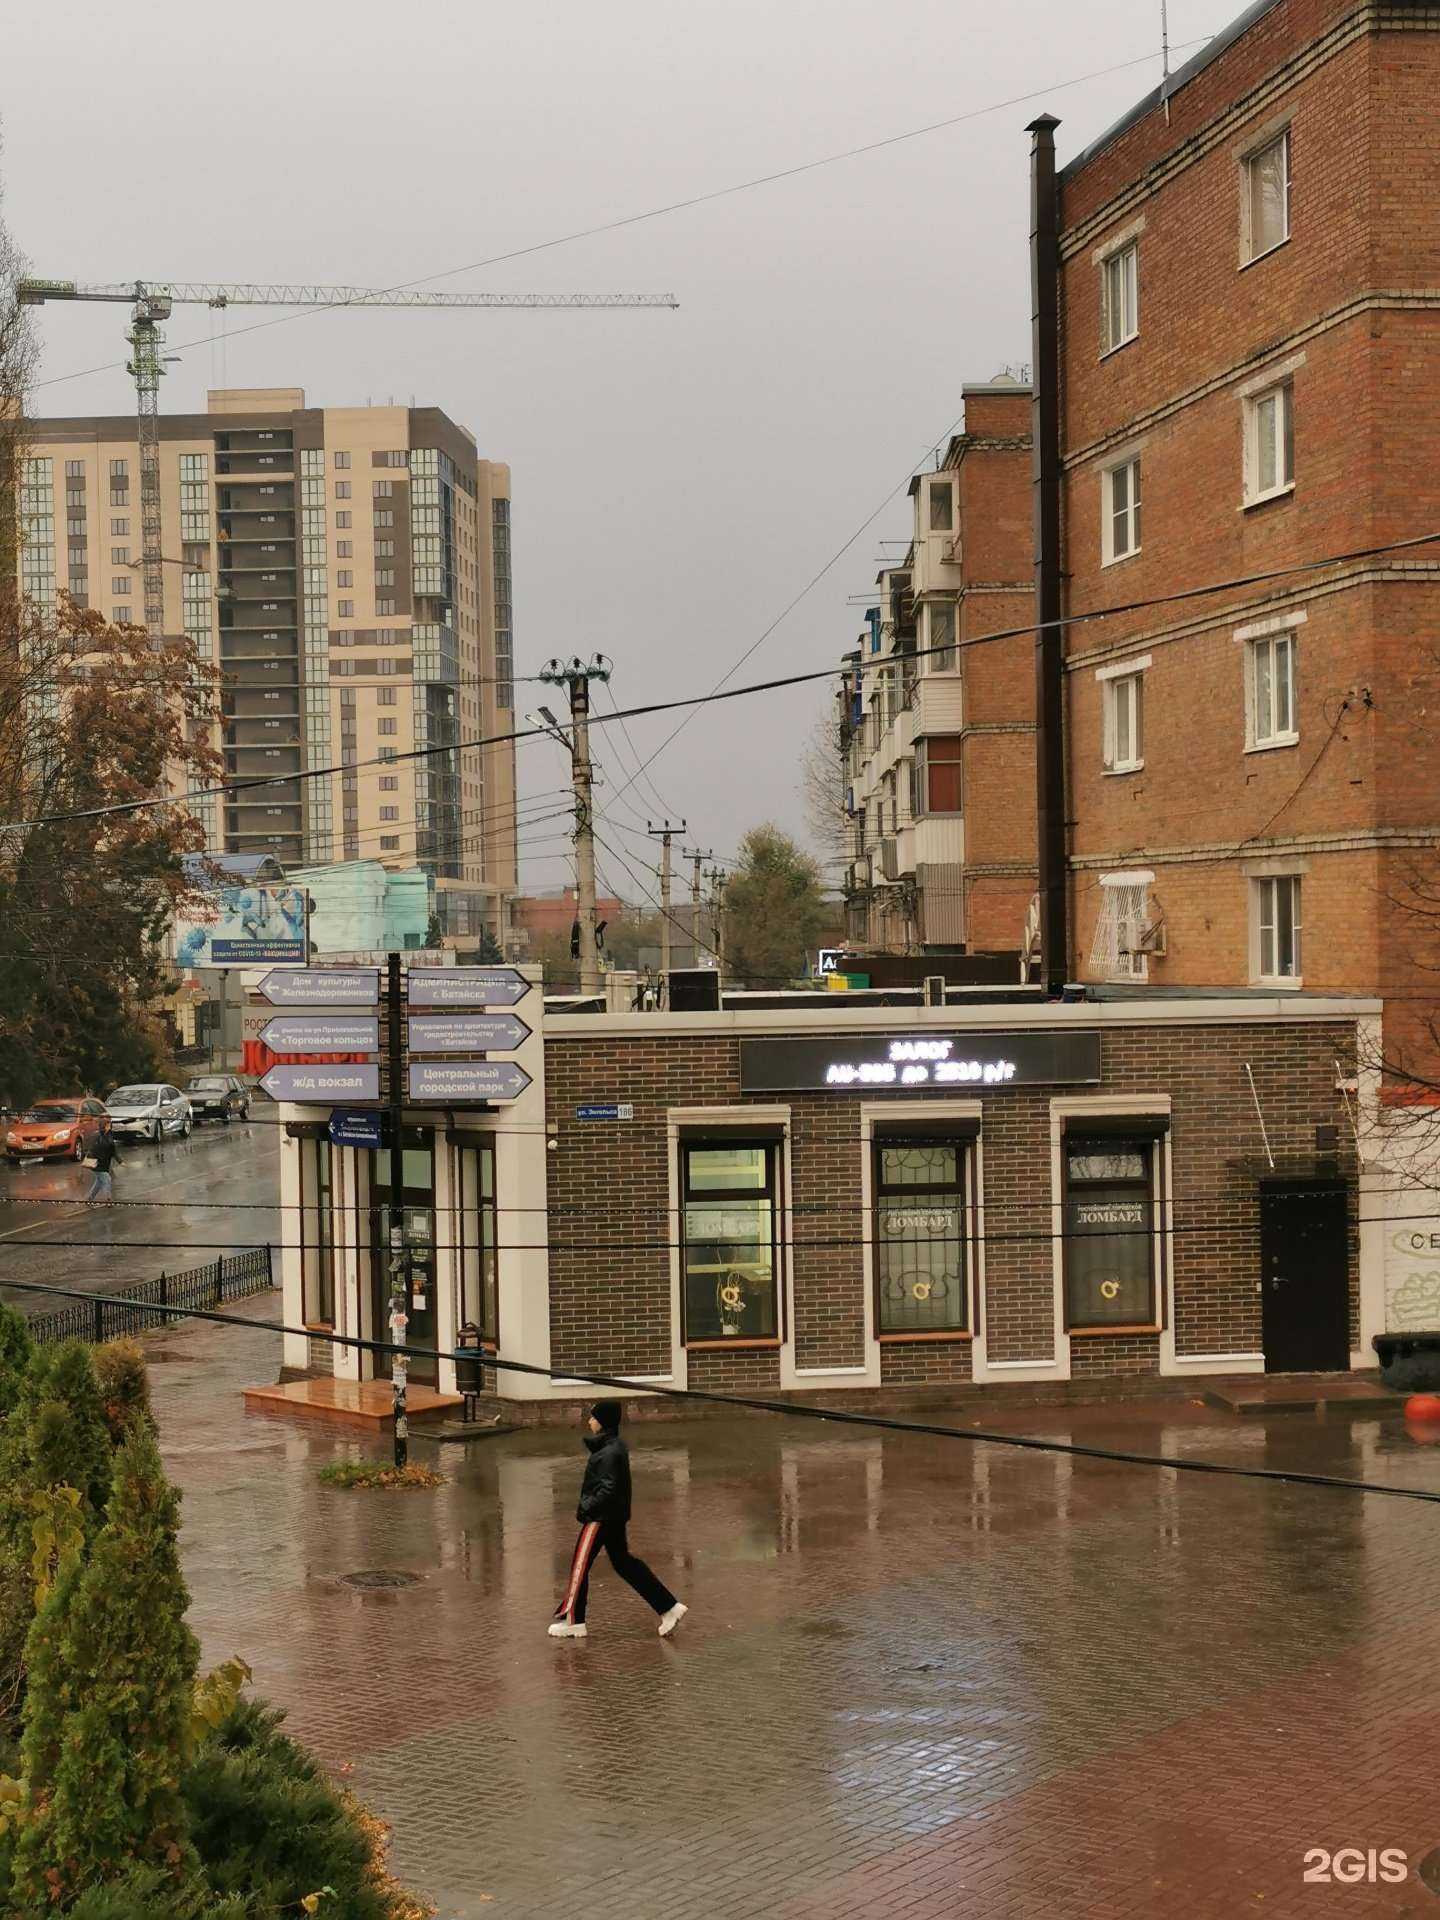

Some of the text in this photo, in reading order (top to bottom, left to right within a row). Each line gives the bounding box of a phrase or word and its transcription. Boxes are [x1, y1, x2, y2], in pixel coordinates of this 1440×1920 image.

[292, 977, 361, 987] Дом культуры
[413, 978, 506, 987] АДМИНИСТРАЦИЯ
[441, 990, 486, 999] Батайска
[281, 1036, 374, 1046] «Торговое кольцо»
[423, 1069, 499, 1080] Центральный
[292, 1077, 363, 1089] ж/д вокзал
[419, 1082, 504, 1093] городской парк
[887, 1215, 953, 1228] ЛОМБАРД
[1077, 1210, 1143, 1224] ЛОМБАРД
